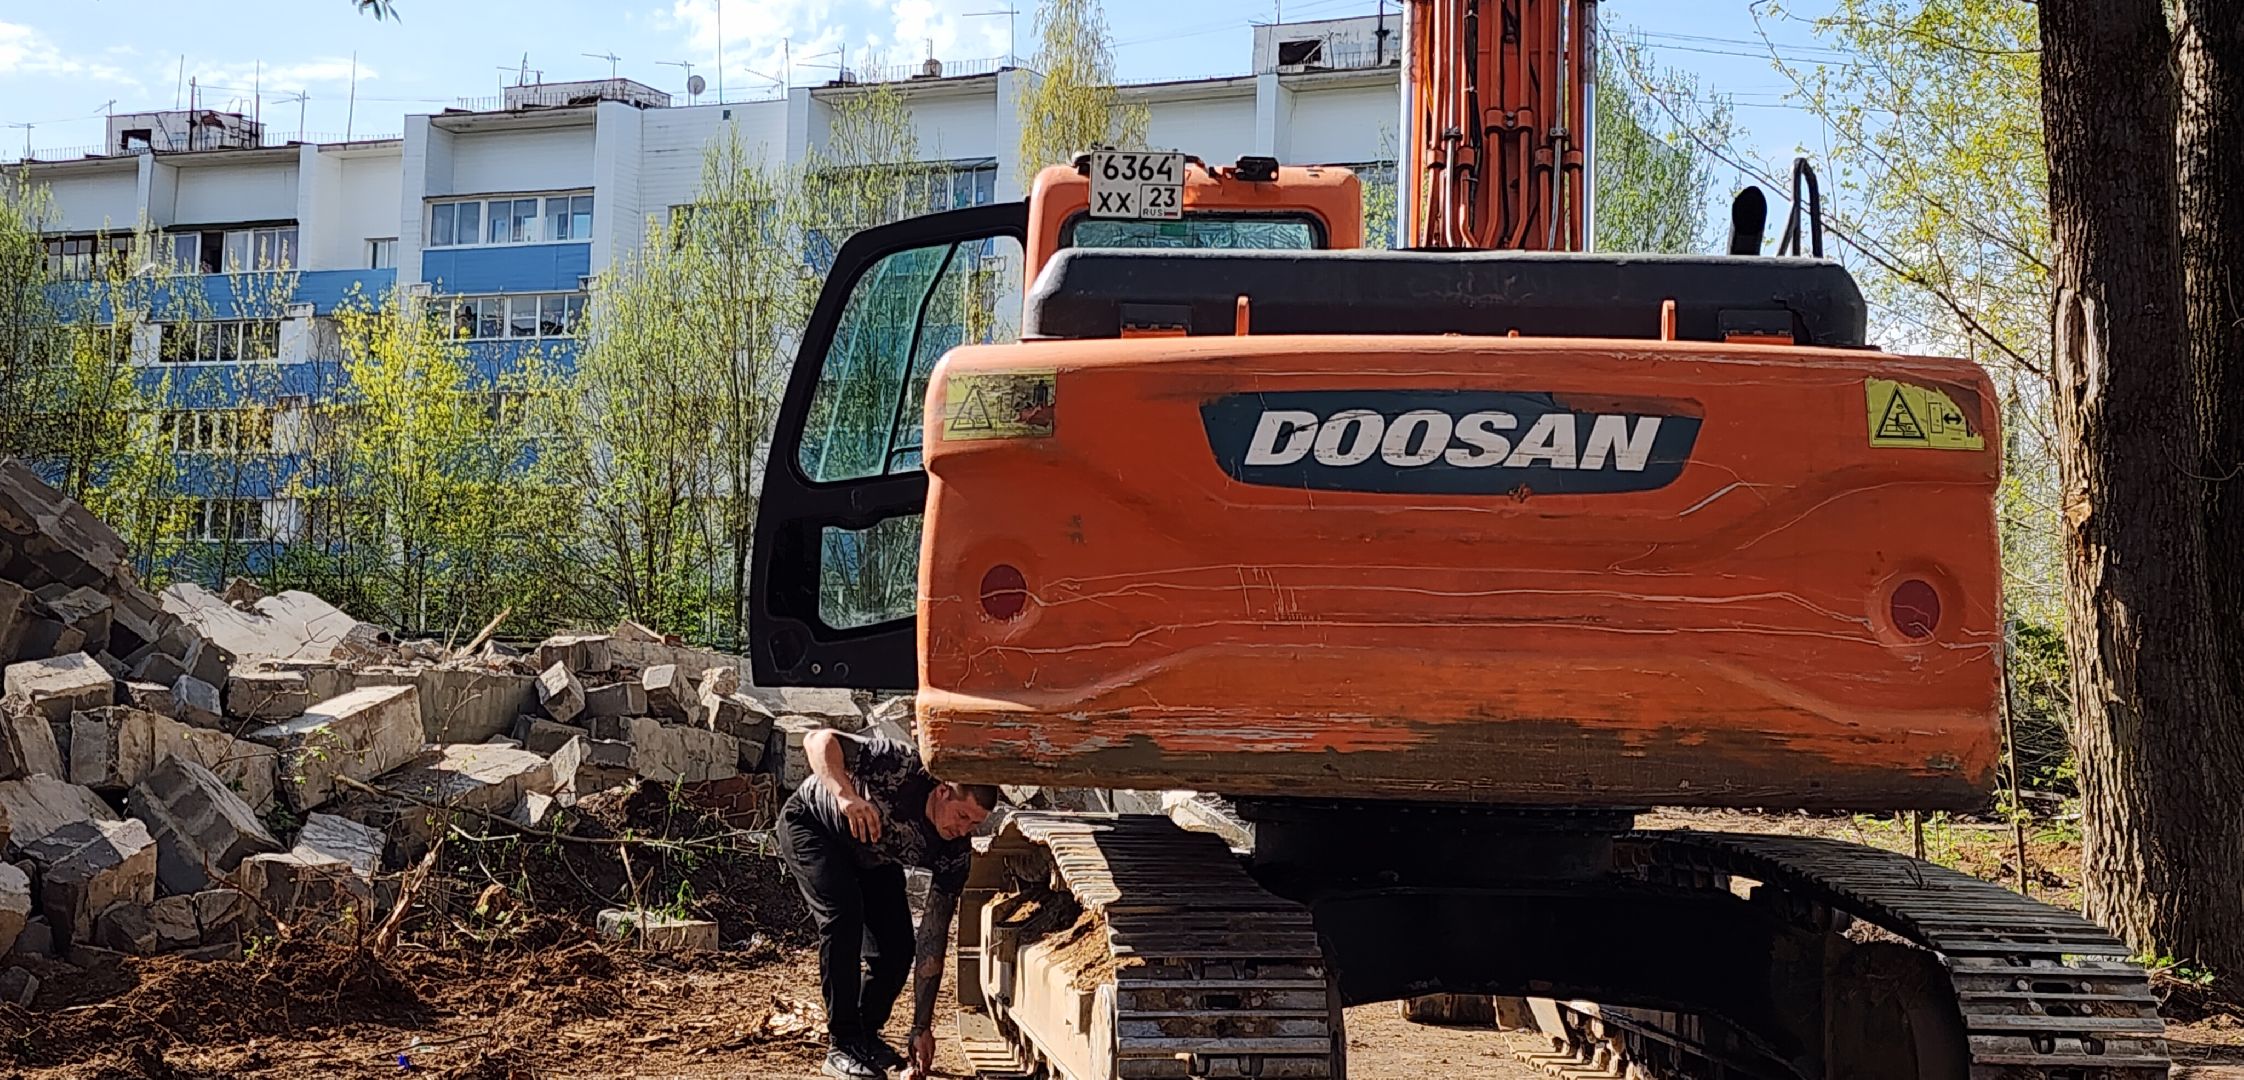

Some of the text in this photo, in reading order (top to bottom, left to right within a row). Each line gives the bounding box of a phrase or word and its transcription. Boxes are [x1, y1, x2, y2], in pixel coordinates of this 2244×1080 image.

[1103, 155, 1172, 182] 6364
[1149, 187, 1176, 207] 23
[1143, 208, 1163, 216] RUS
[1244, 409, 1662, 472] DOOSAN
